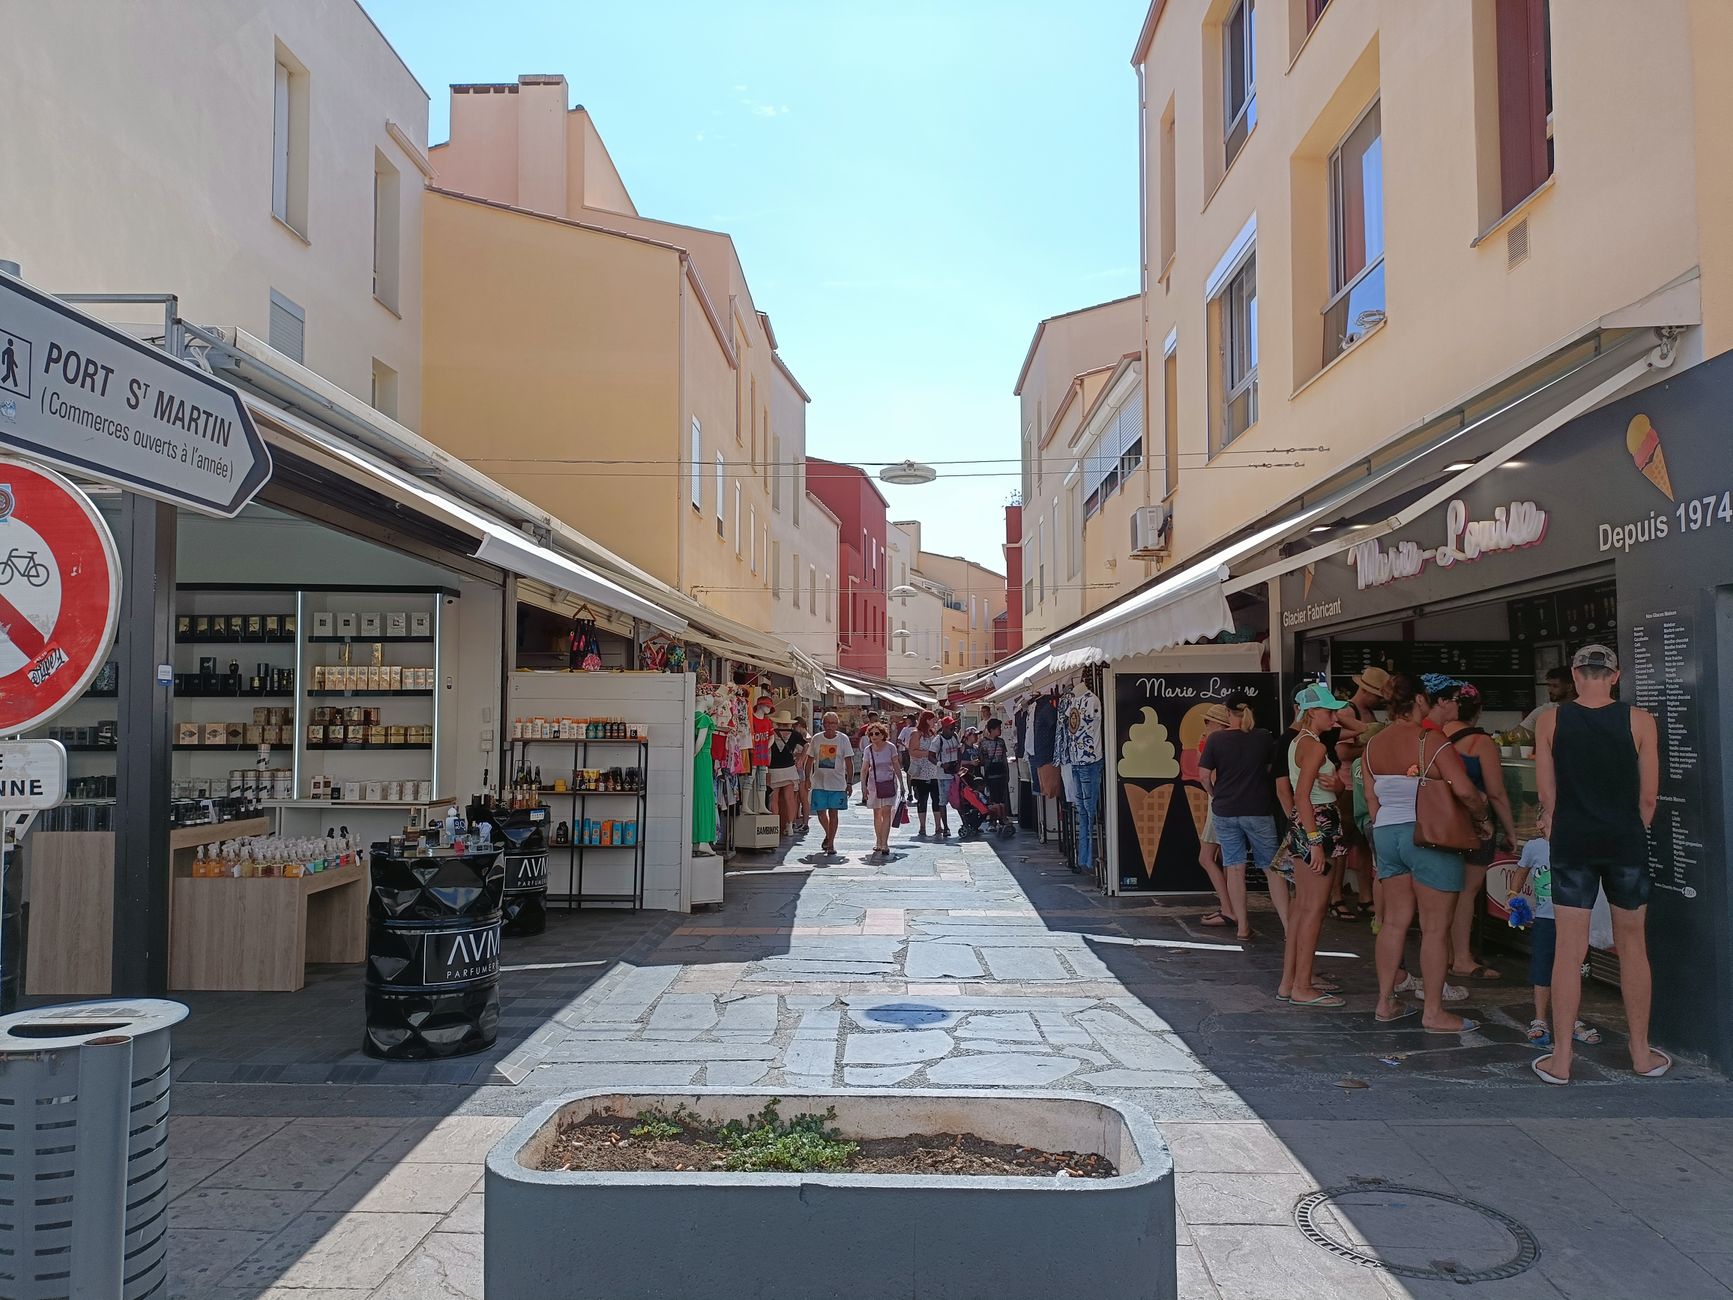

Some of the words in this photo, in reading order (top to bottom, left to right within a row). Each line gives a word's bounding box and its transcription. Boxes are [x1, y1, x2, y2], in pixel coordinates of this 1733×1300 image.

[44, 342, 115, 397] PORT
[153, 390, 233, 447] MARTIN
[41, 386, 130, 442] (Commerces
[133, 429, 178, 459] ouverts
[181, 444, 188, 463] à
[191, 445, 234, 483] l'année)
[1598, 510, 1669, 553] Depuis
[1676, 491, 1733, 533] 1974
[1283, 608, 1306, 627] Glacier
[1307, 597, 1342, 621] Fabricant
[1136, 678, 1197, 698] Marie
[1200, 677, 1259, 699] Lose
[447, 926, 500, 966] AVM
